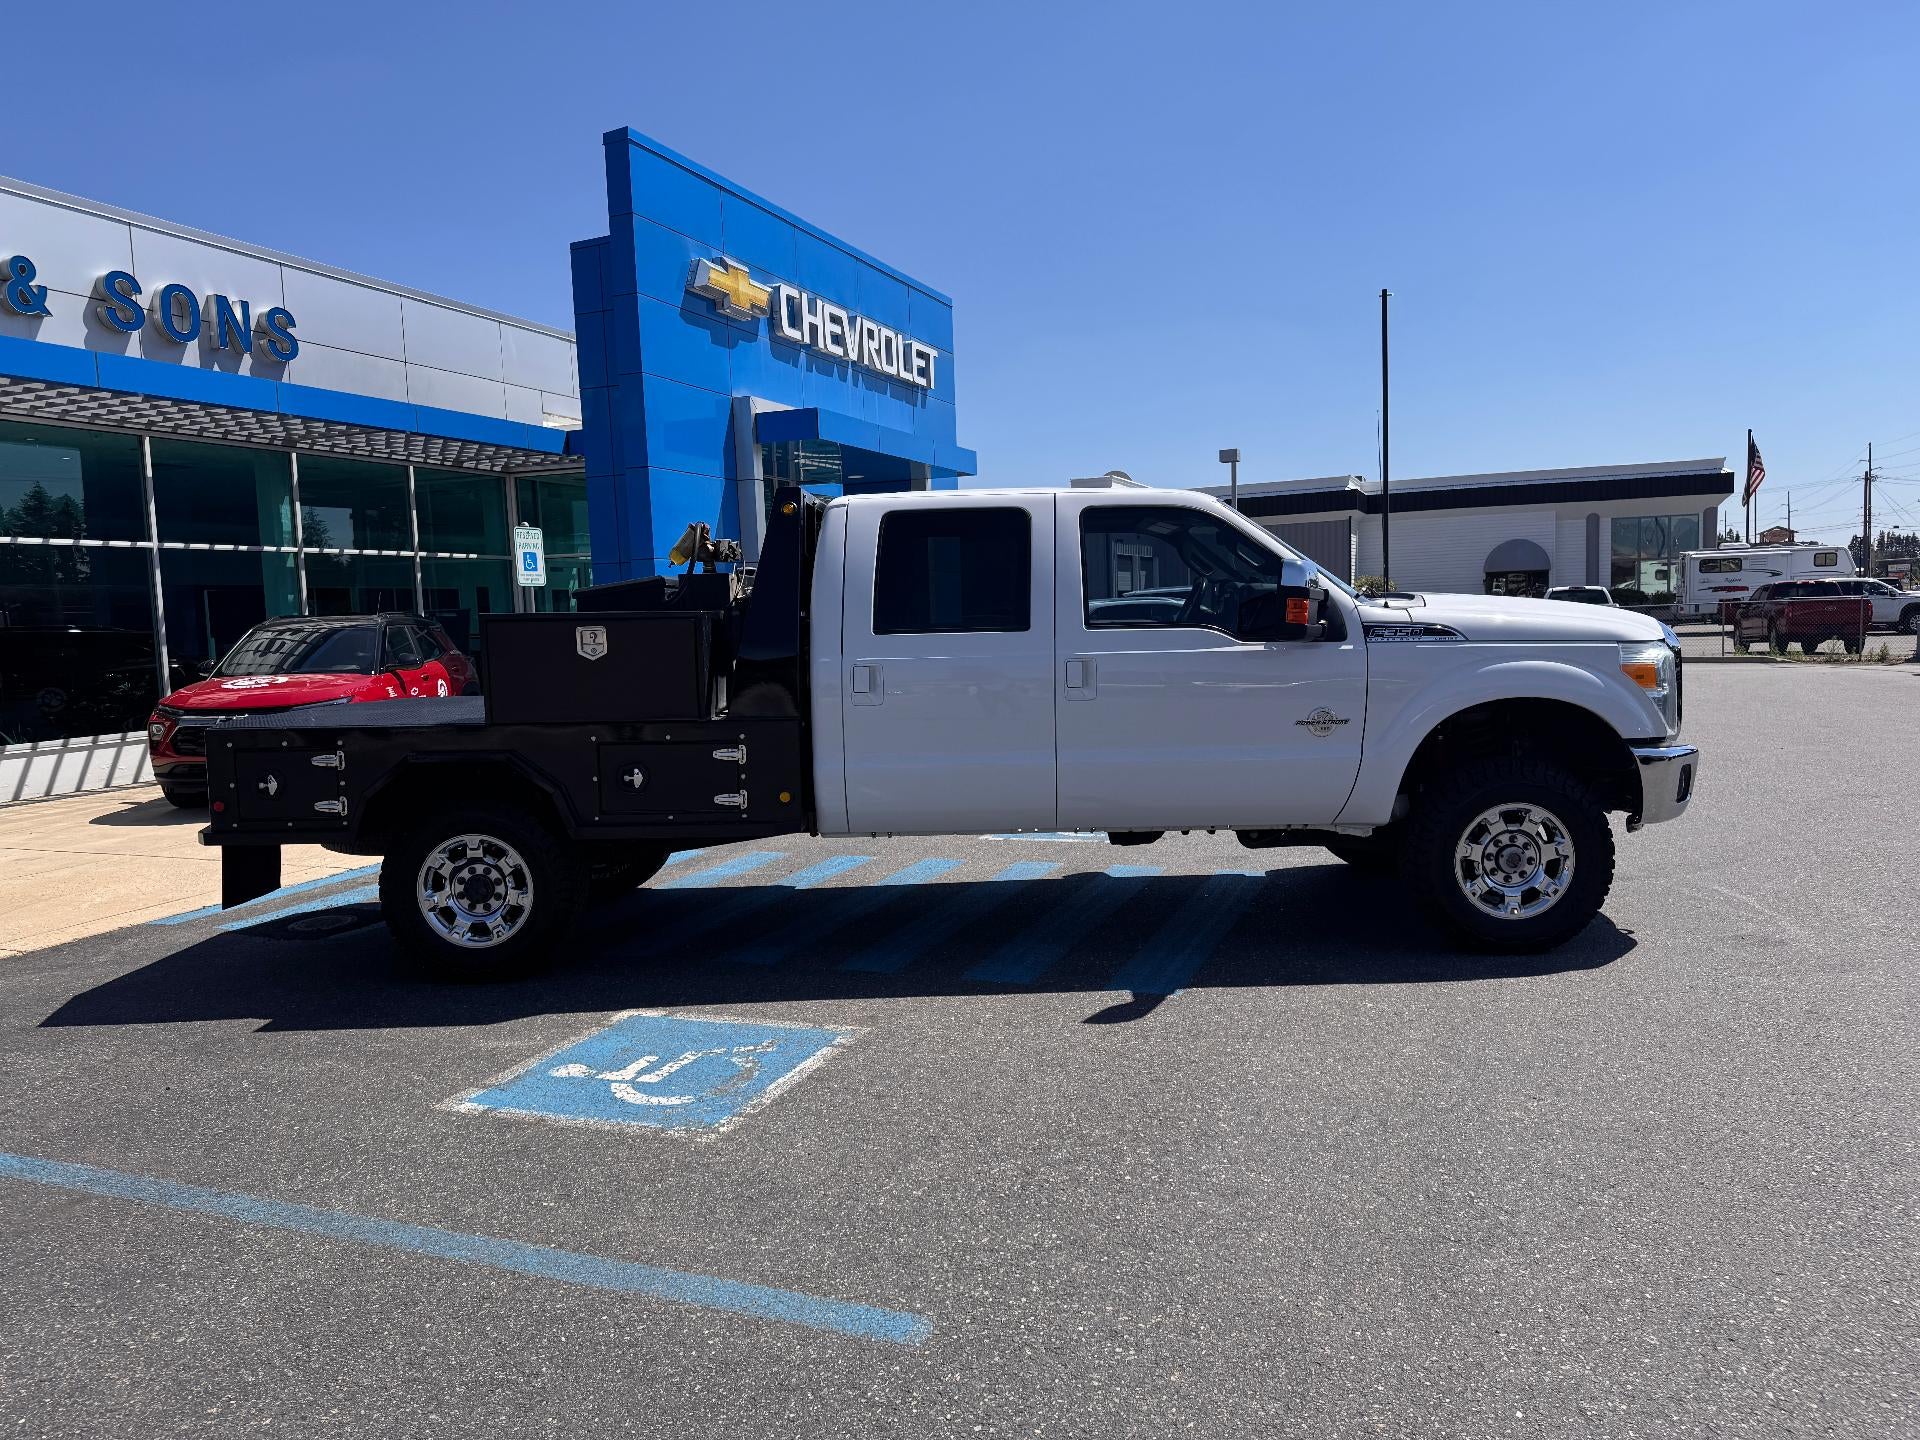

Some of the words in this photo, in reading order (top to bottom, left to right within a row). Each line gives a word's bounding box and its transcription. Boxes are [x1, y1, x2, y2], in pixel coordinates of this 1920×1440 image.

[1, 255, 53, 317] &
[98, 270, 300, 362] SONS
[770, 283, 939, 390] CHEVROLET
